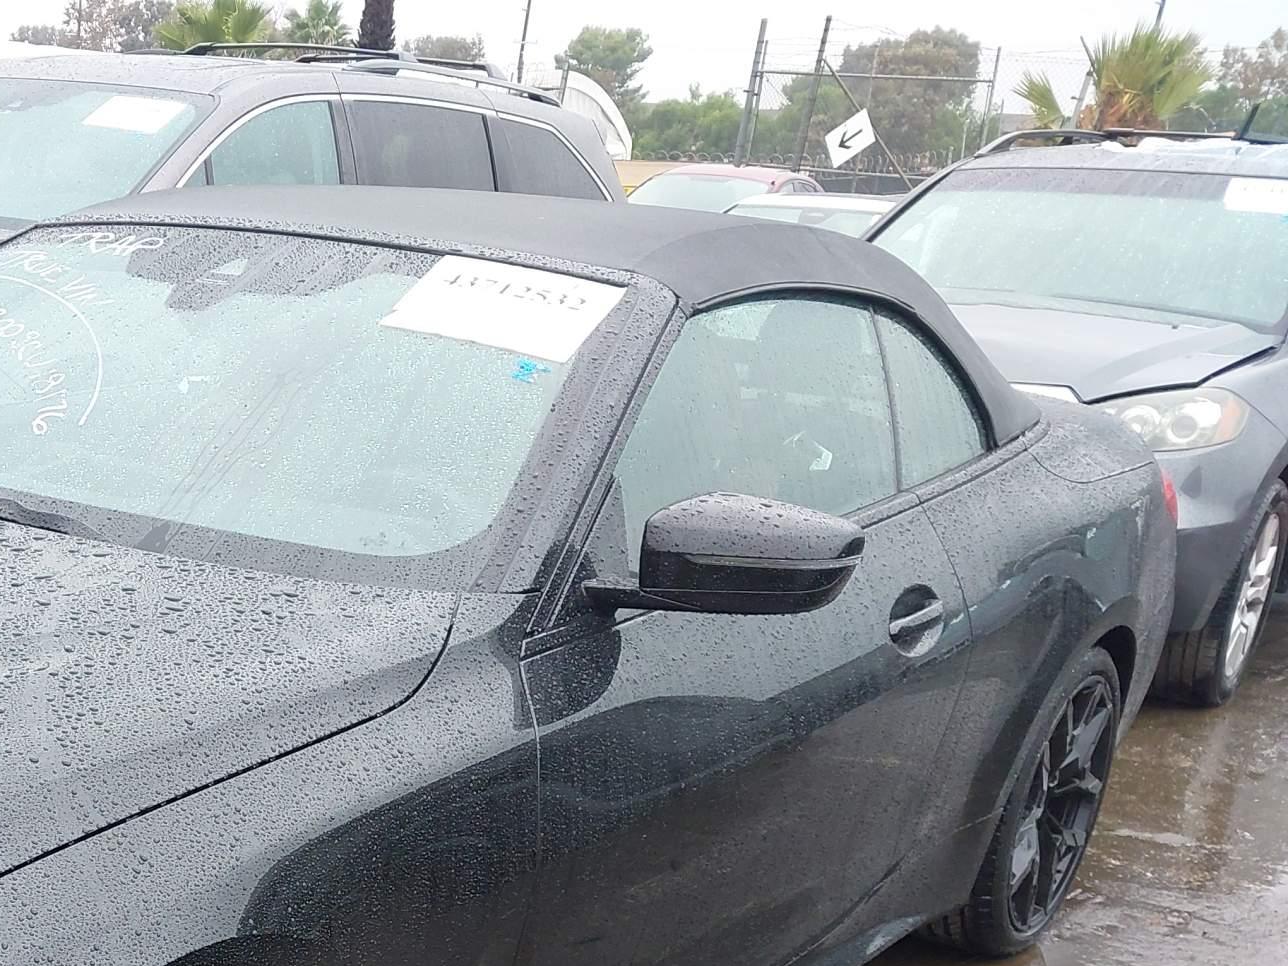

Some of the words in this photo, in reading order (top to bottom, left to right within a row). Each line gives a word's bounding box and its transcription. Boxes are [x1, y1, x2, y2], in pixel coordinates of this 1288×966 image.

[56, 232, 166, 256] TRAP
[9, 248, 70, 282] TRUE
[443, 273, 588, 311] 43712532
